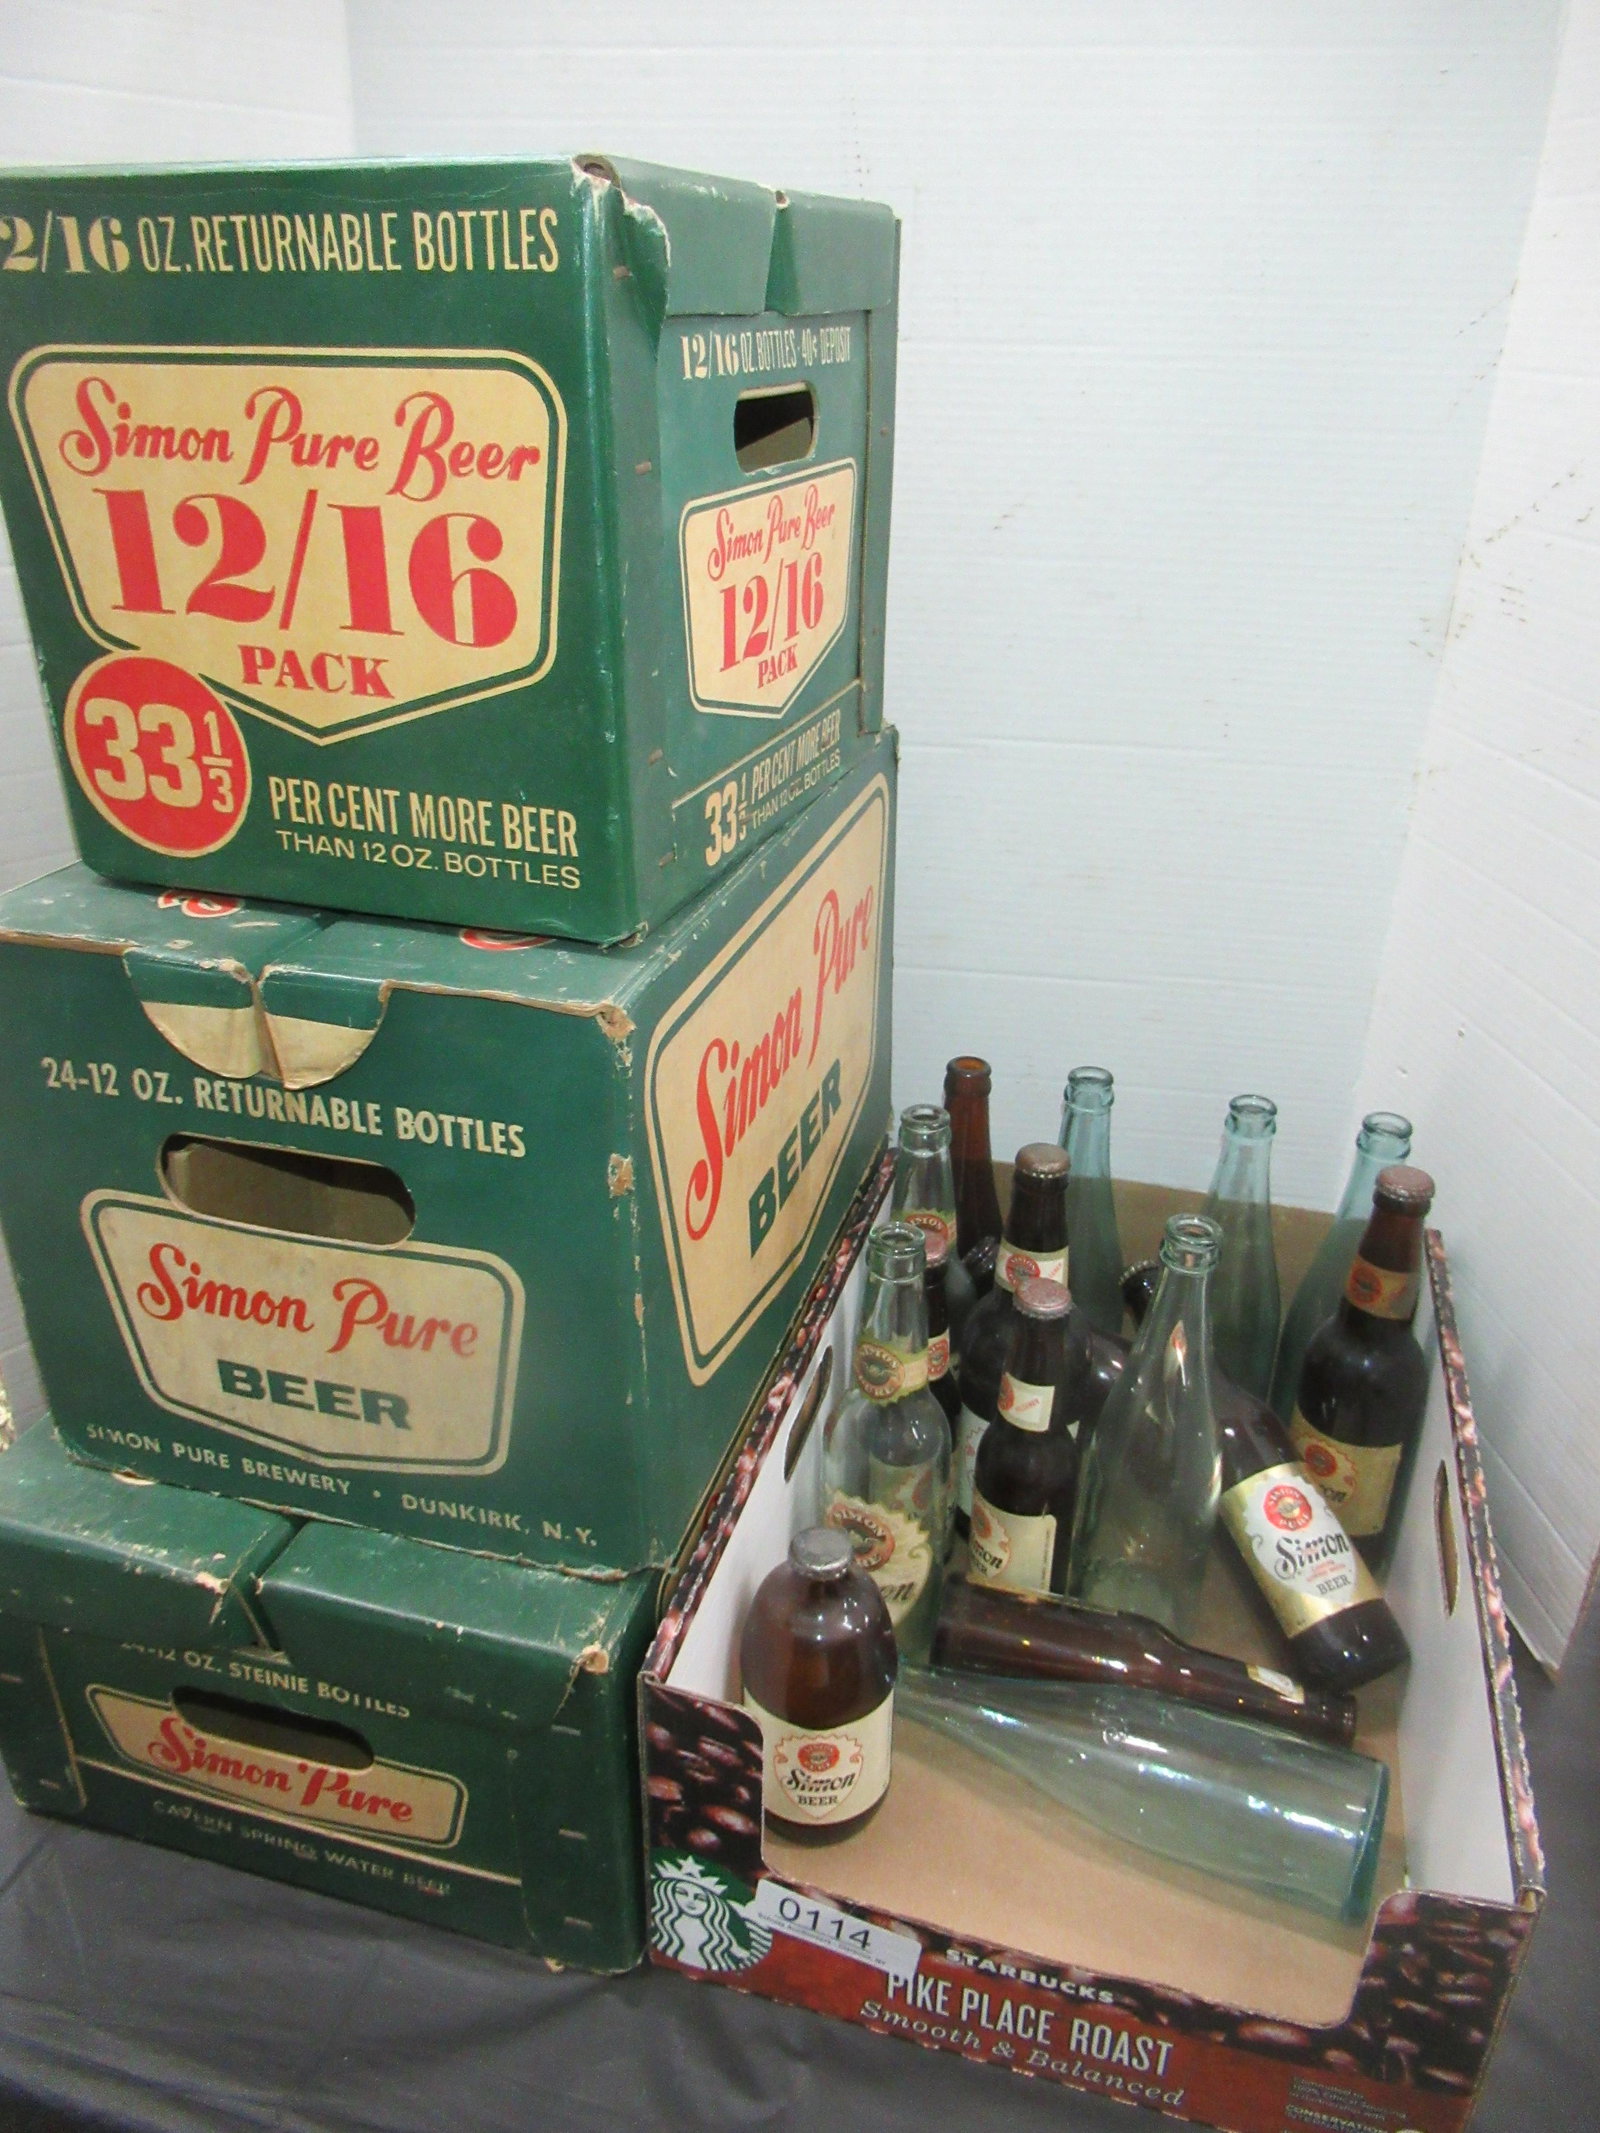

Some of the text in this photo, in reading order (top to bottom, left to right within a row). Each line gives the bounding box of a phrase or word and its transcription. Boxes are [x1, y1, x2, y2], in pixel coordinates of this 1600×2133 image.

[138, 217, 194, 272] OZ.
[192, 212, 402, 272] RETURNABLE
[413, 208, 560, 272] BOTTLES
[681, 330, 738, 380] 12/16
[757, 329, 797, 371] BOTTLES
[821, 326, 851, 366] DEPOSIT
[59, 376, 541, 502] Simon Pure Beer
[92, 488, 519, 648] 12/16
[708, 484, 835, 581] Simon Pure Beer
[719, 552, 824, 672] 12/16
[239, 645, 396, 700] PACK
[757, 643, 798, 689] PACK
[752, 757, 773, 805] PER
[771, 739, 797, 790] CENT
[796, 720, 820, 772] MORE
[752, 796, 779, 830] THAN
[804, 748, 841, 791] BOTTLES
[268, 776, 578, 857] PER CENT MORE BEER
[275, 830, 580, 889] THAN 12 OZ. BOTTLES
[686, 884, 874, 1242] Simon Pure
[40, 1057, 527, 1158] 24-12 OZ. RETURNABLE BOTTLES
[748, 1058, 843, 1260] BEER
[136, 1242, 479, 1358] Simon Pure
[216, 1358, 414, 1431] BEER
[86, 1424, 162, 1454] SIMON
[172, 1442, 231, 1470] PURE
[242, 1456, 350, 1496] BREWERY
[1274, 1532, 1350, 1580] Simon
[1316, 1574, 1351, 1595] BEER
[228, 1661, 309, 1694] STEINIE
[148, 1717, 414, 1823] Simon Pure
[786, 1768, 856, 1793] Simon
[797, 1795, 838, 1806] BEER
[778, 1897, 873, 1951] 0114
[945, 1949, 1116, 2005] STARBUCKS
[859, 1998, 1185, 2107] Smooth & Balanced
[885, 1972, 1174, 2078] PIKE PLACE ROAST
